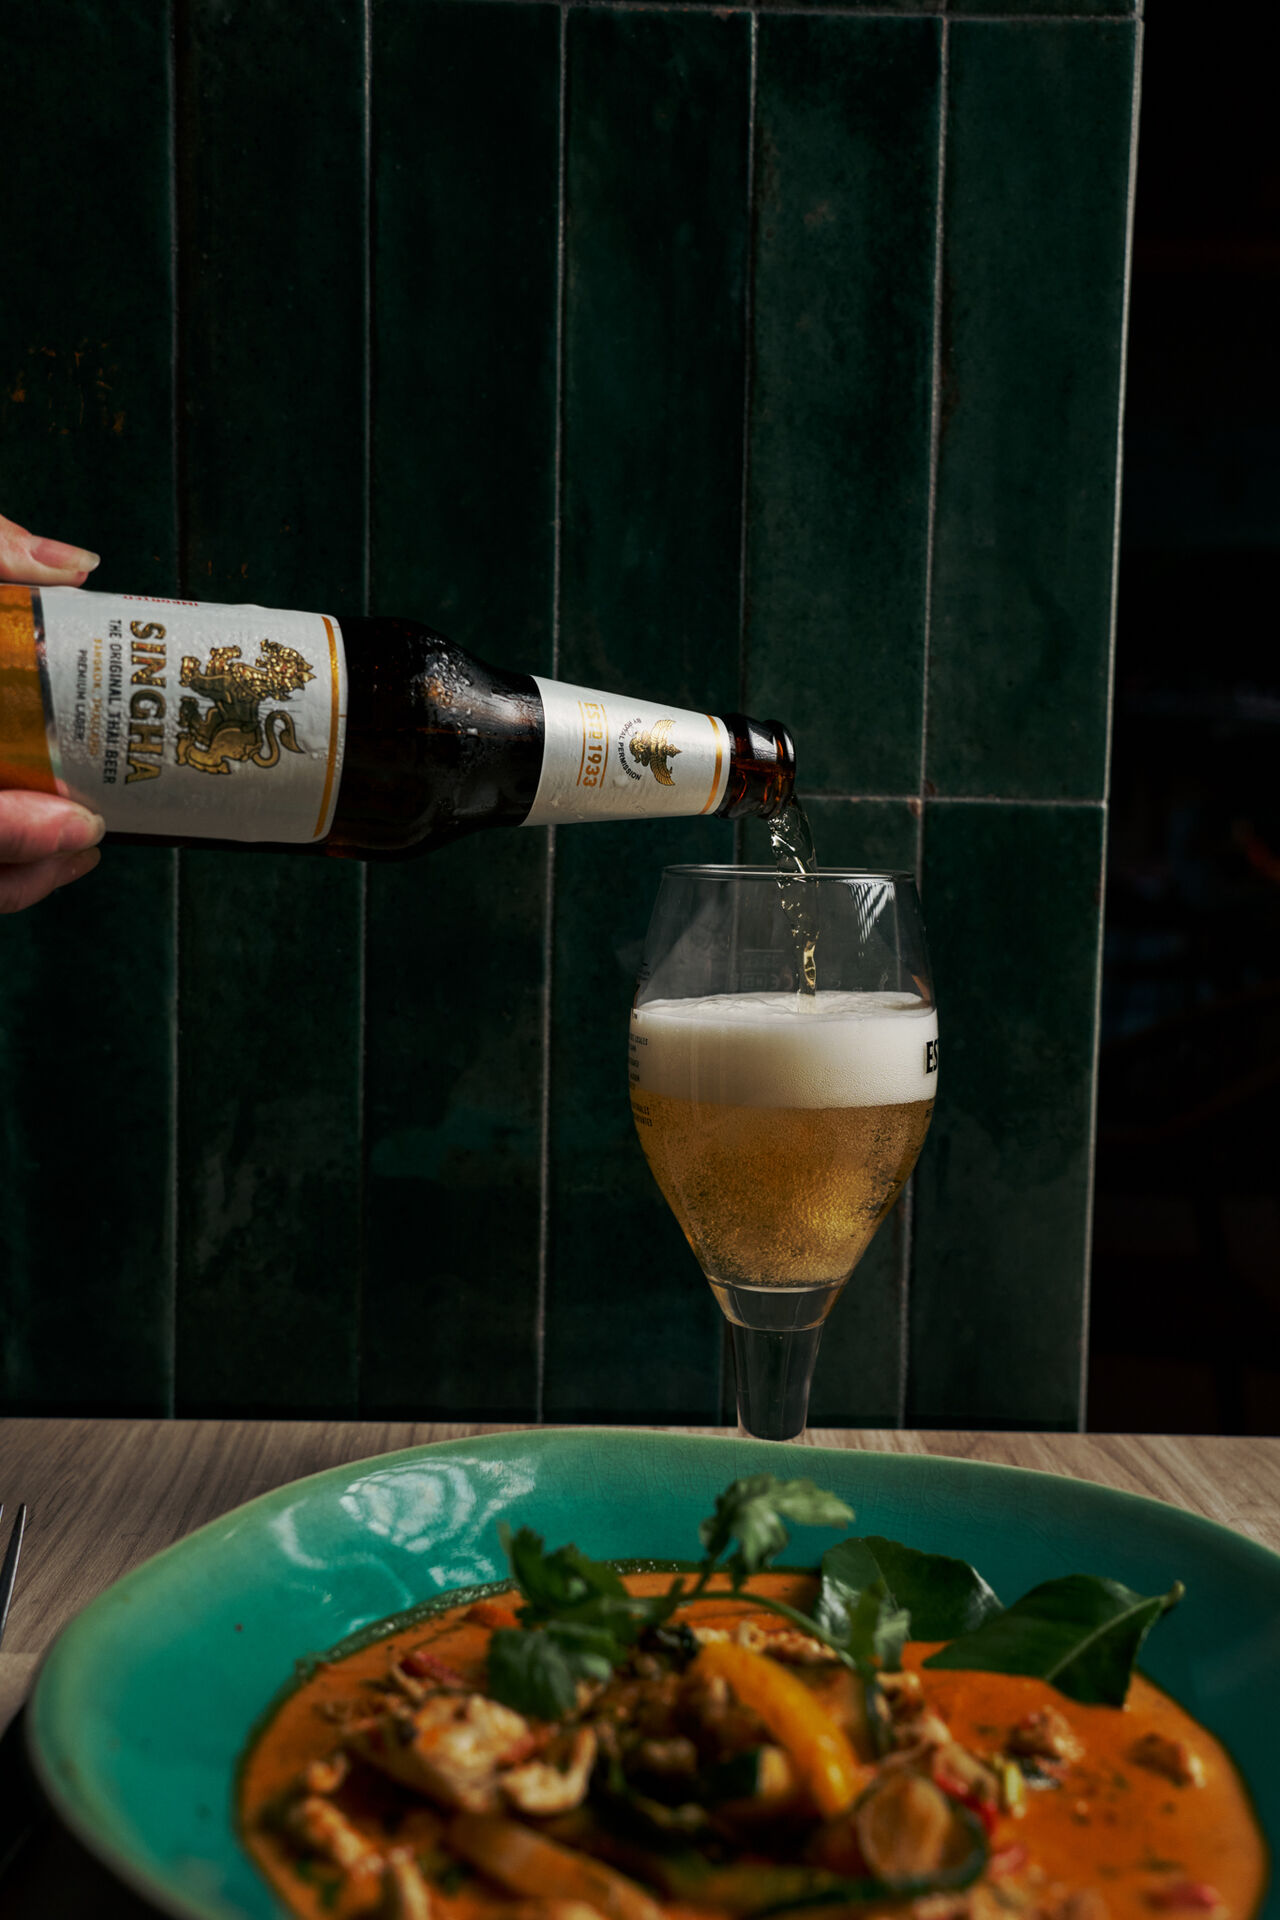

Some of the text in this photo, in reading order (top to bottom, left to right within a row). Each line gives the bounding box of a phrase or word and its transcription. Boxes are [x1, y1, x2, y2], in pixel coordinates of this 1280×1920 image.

[76, 649, 88, 700] PREMIUM
[103, 619, 122, 784] THE ORIGINAL THAI BEER
[125, 620, 167, 785] SINGHA
[618, 721, 633, 740] ROYAL
[583, 745, 603, 787] 1933
[618, 741, 642, 780] PERMISSION
